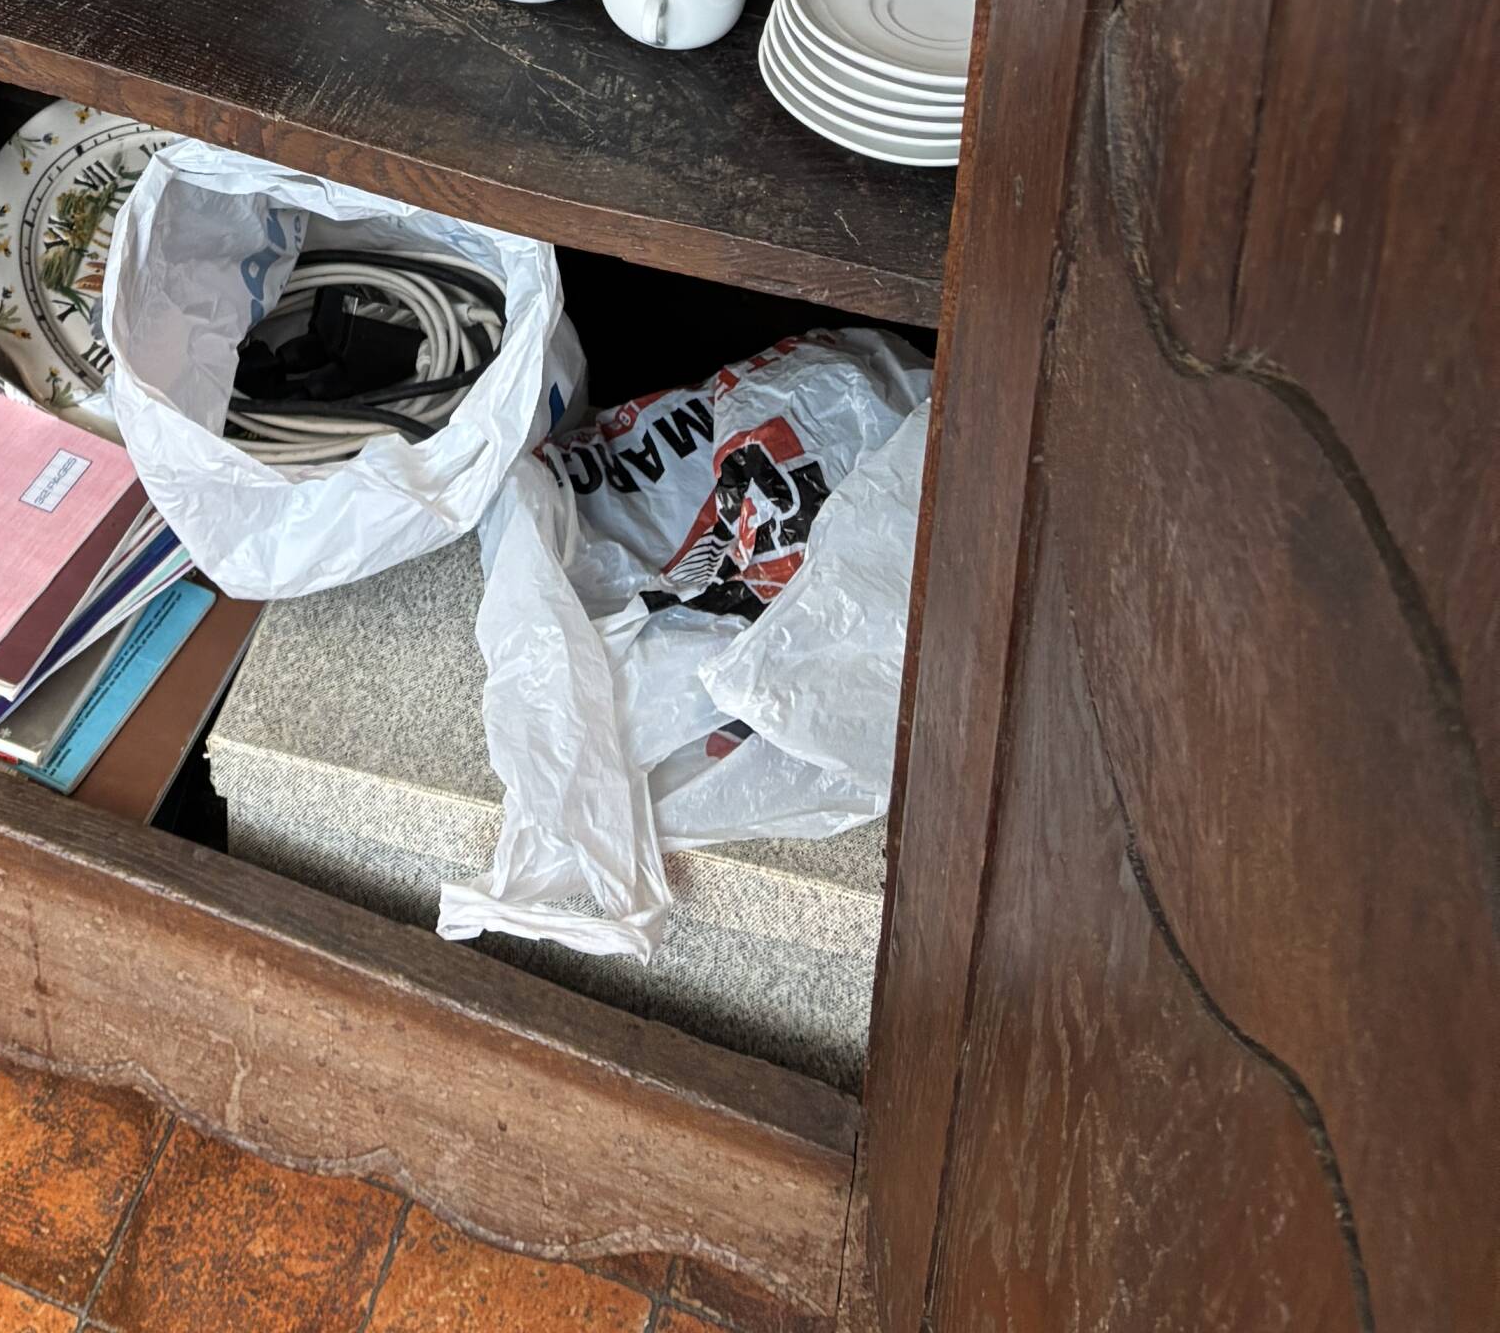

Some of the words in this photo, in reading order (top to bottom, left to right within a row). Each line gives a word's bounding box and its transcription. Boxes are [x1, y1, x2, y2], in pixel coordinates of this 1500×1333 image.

[74, 161, 117, 191] VII
[52, 299, 78, 323] V
[46, 456, 77, 490] PAGES
